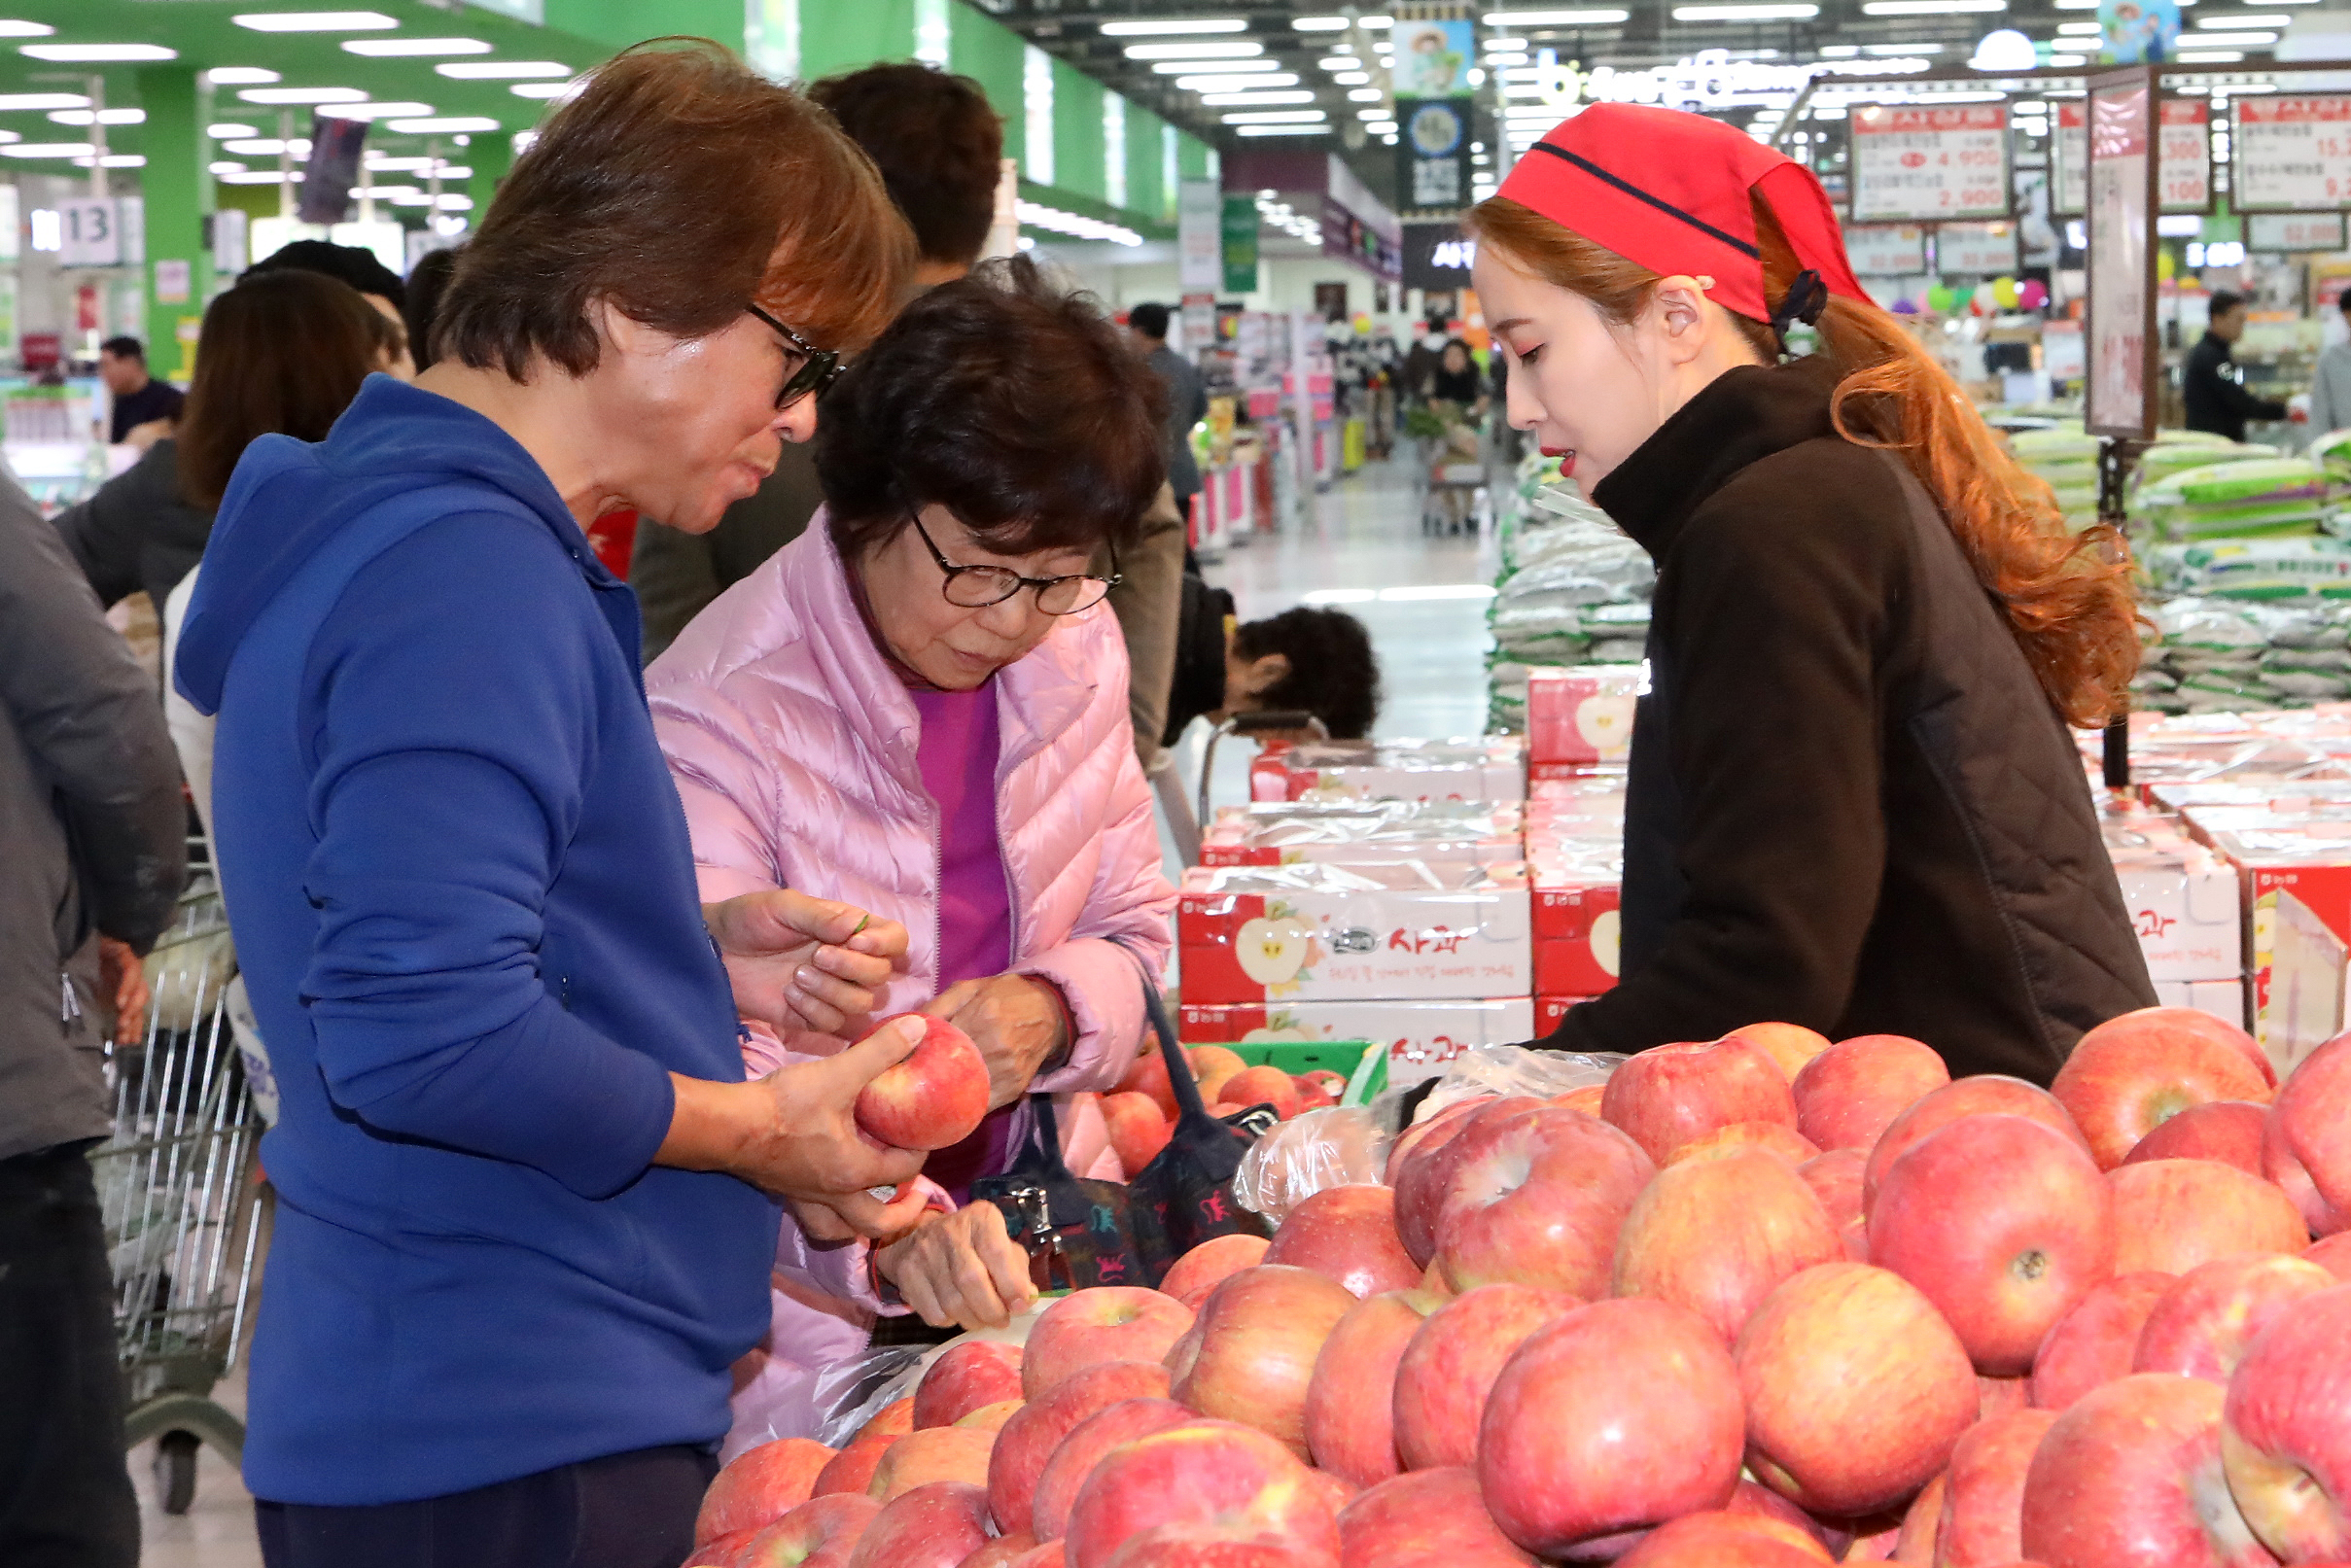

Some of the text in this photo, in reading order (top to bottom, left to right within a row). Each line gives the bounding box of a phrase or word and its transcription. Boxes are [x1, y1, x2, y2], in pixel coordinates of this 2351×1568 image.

[69, 206, 108, 243] 13
[2129, 910, 2177, 938] 과
[1387, 925, 1469, 955] 사과
[1390, 1035, 1469, 1063] 사과
